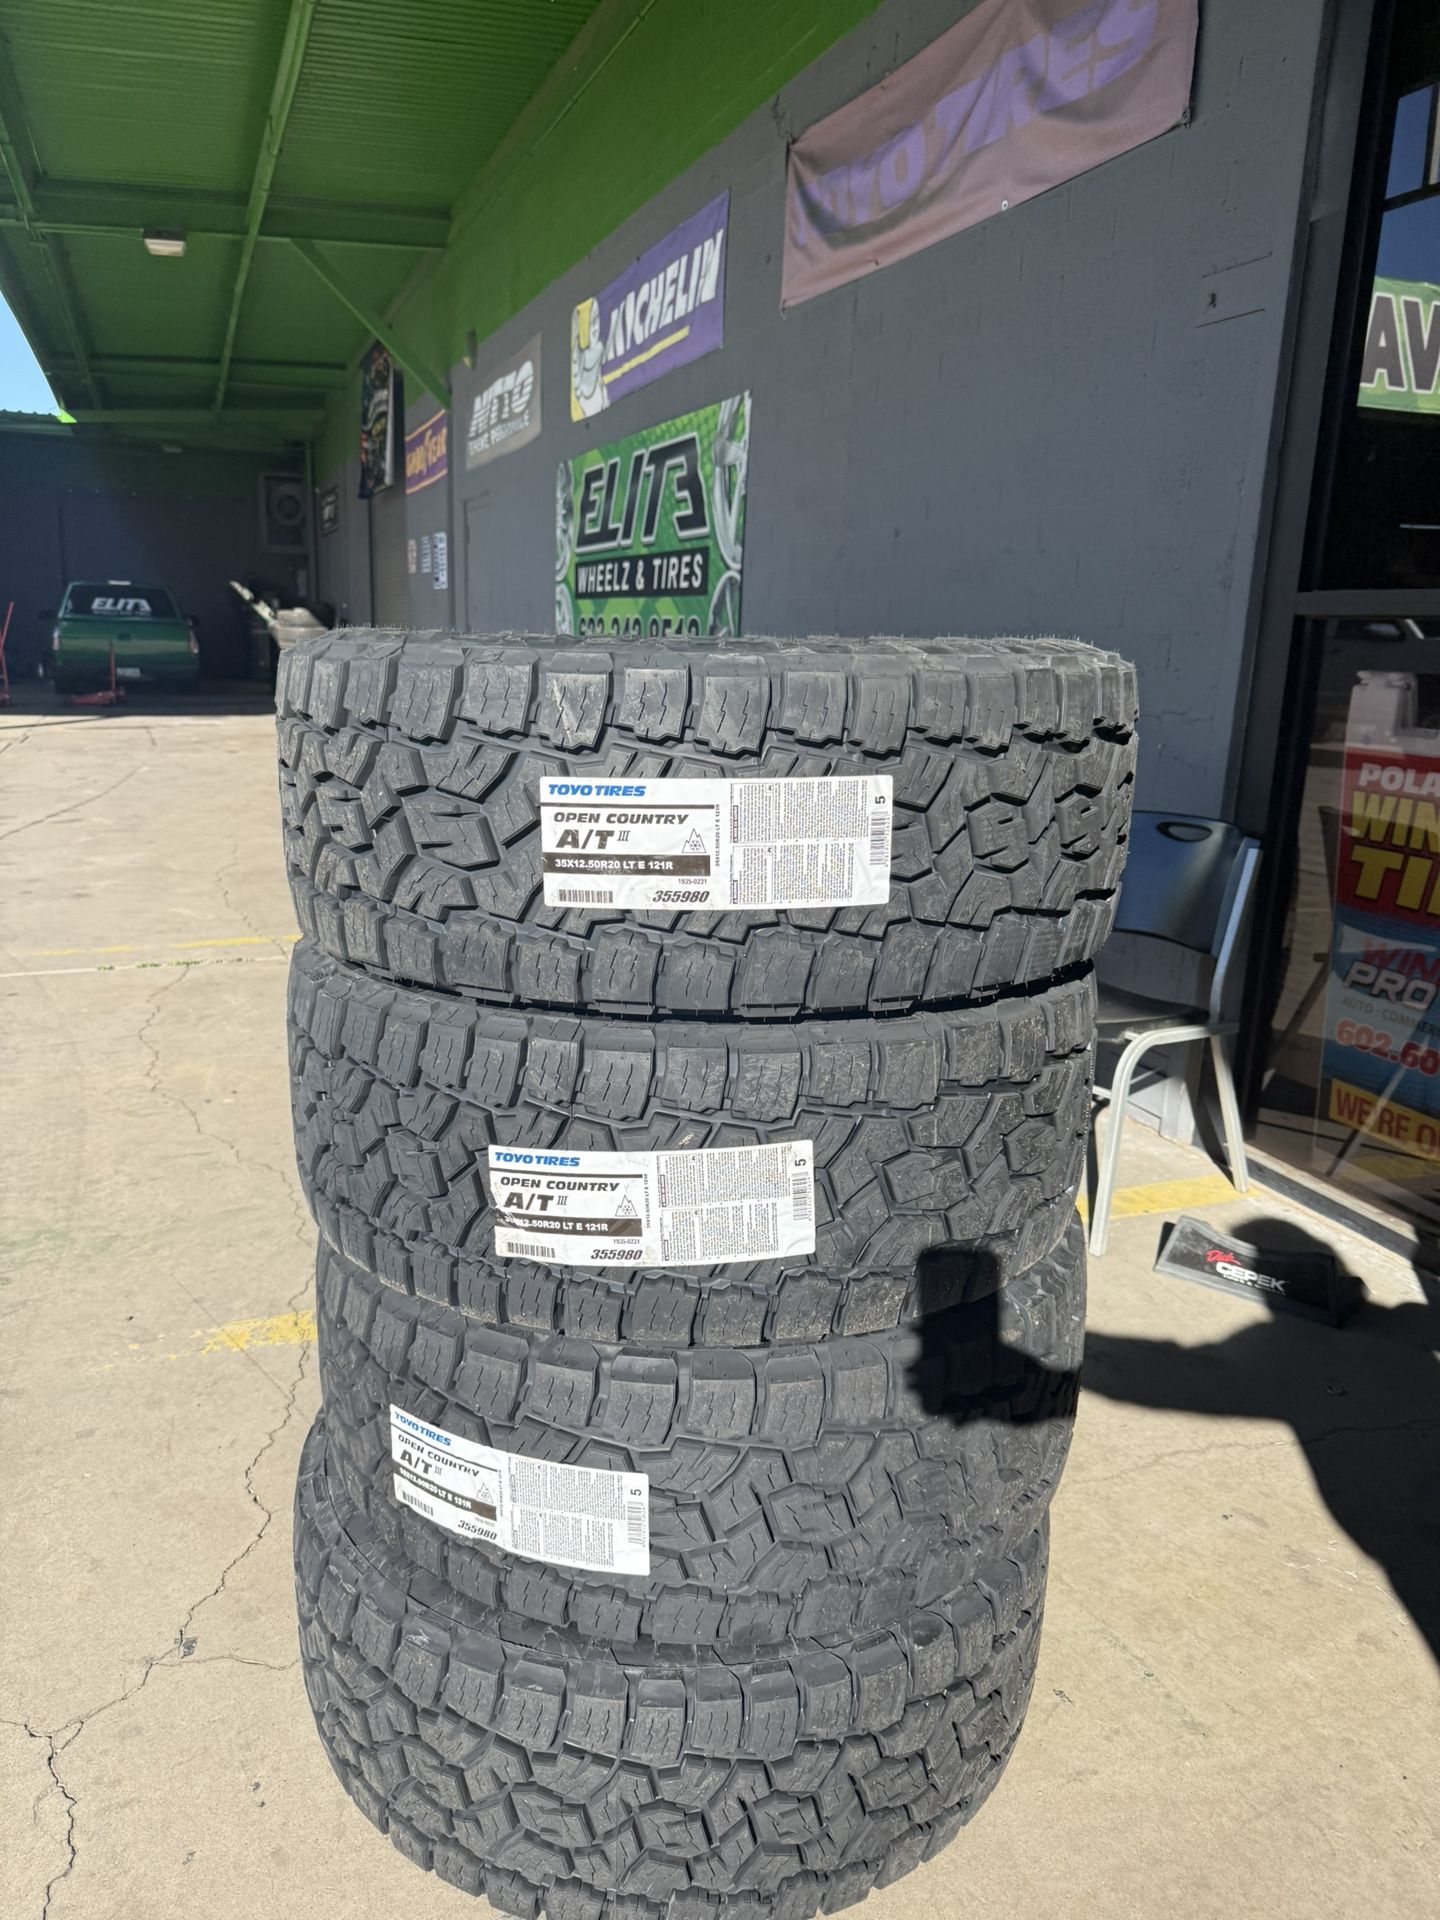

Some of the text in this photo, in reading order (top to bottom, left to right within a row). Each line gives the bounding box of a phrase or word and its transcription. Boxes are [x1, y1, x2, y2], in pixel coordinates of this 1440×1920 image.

[602, 228, 724, 364] MICHELIN
[577, 553, 703, 594] WHEELZ & TIRES
[1359, 762, 1440, 797] POLA
[548, 784, 647, 797] TOYO TIRES
[875, 795, 886, 805] 5
[553, 812, 689, 825] OPEN COUNTRY
[555, 829, 615, 850] A/T
[555, 858, 674, 870] 35X12.50R20 LT E 121R
[652, 890, 710, 903] 355980
[1343, 960, 1438, 1011] PRO
[495, 1151, 580, 1167] TOYO TIRES
[794, 1158, 807, 1167] 5
[500, 1176, 620, 1192] OPEN COUNTRY
[503, 1192, 554, 1212] A/T
[562, 1222, 574, 1230] LT
[585, 1223, 608, 1231] 121R
[590, 1249, 643, 1260] 355980
[1216, 1262, 1285, 1292] CEPEK
[398, 1434, 480, 1477] OPEN COUNTRY
[400, 1449, 433, 1475] A/T
[630, 1488, 642, 1497] 5
[457, 1519, 498, 1541] 355980
